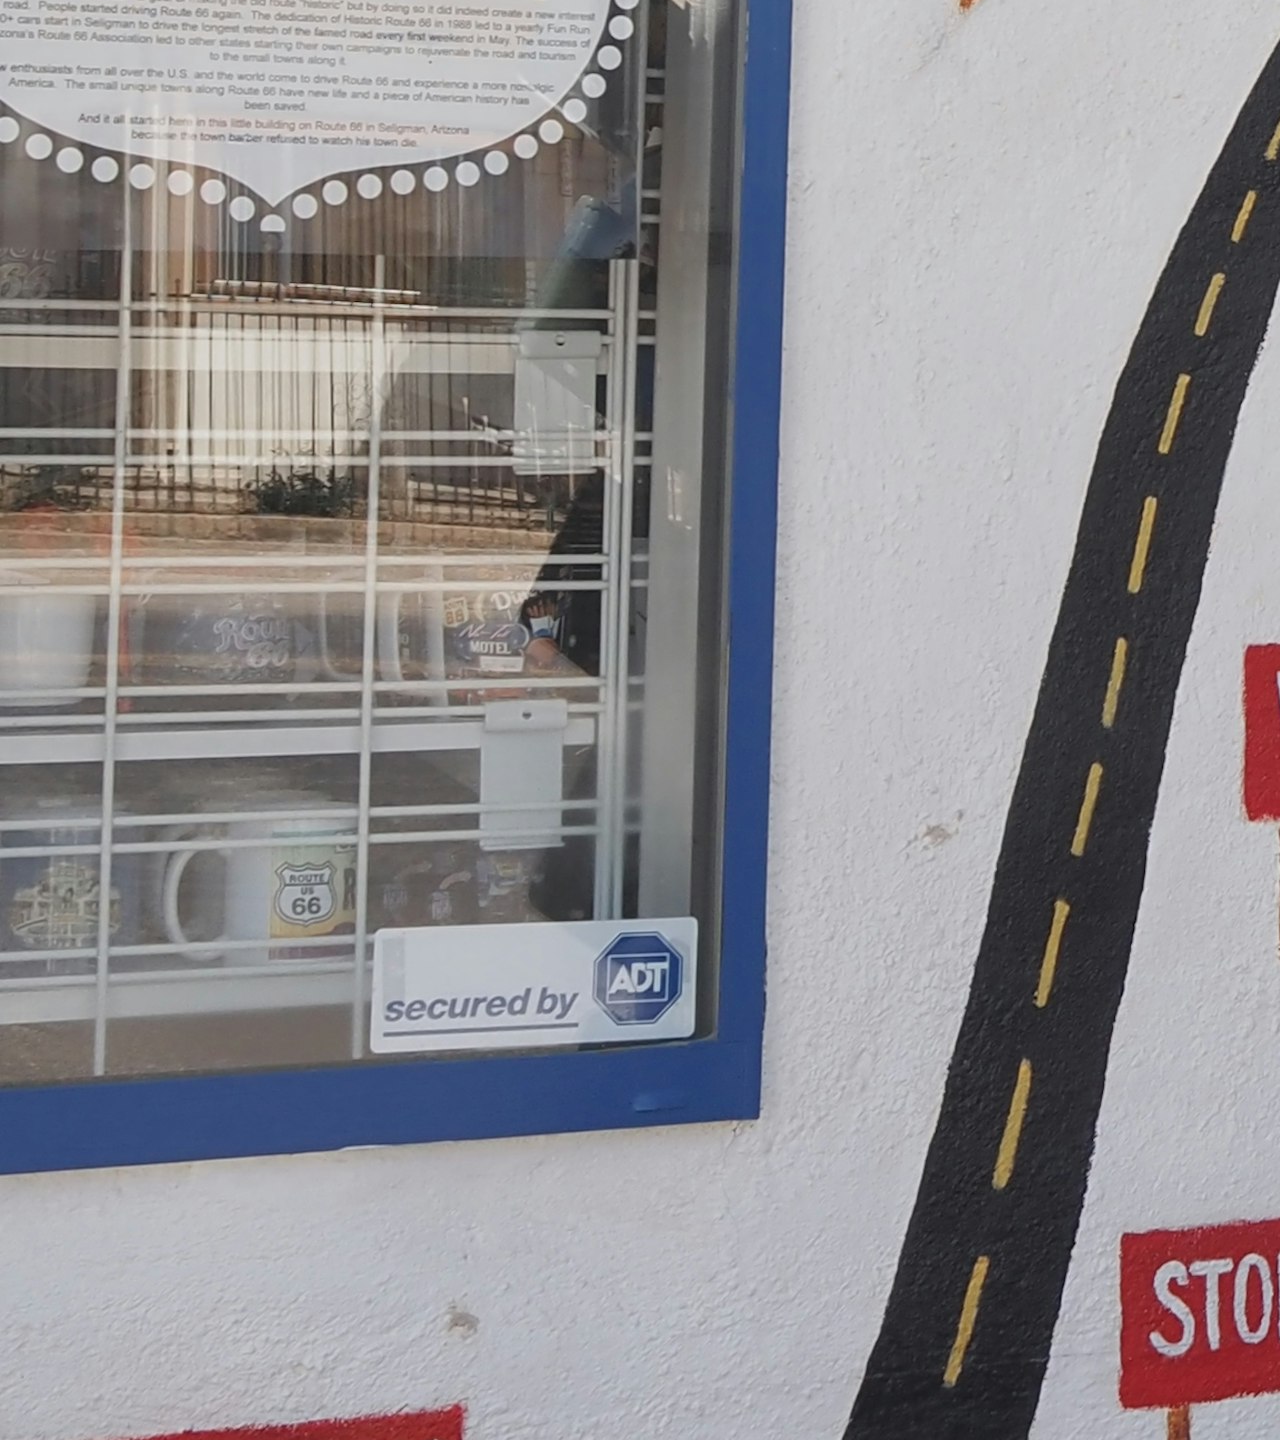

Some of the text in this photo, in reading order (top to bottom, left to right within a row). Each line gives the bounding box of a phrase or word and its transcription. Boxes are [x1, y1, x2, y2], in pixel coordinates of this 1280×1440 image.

[470, 640, 512, 655] MOTEL
[289, 872, 326, 885] ROUTE
[300, 886, 315, 896] US
[291, 898, 322, 916] 66
[384, 962, 668, 1022] secured by ADT
